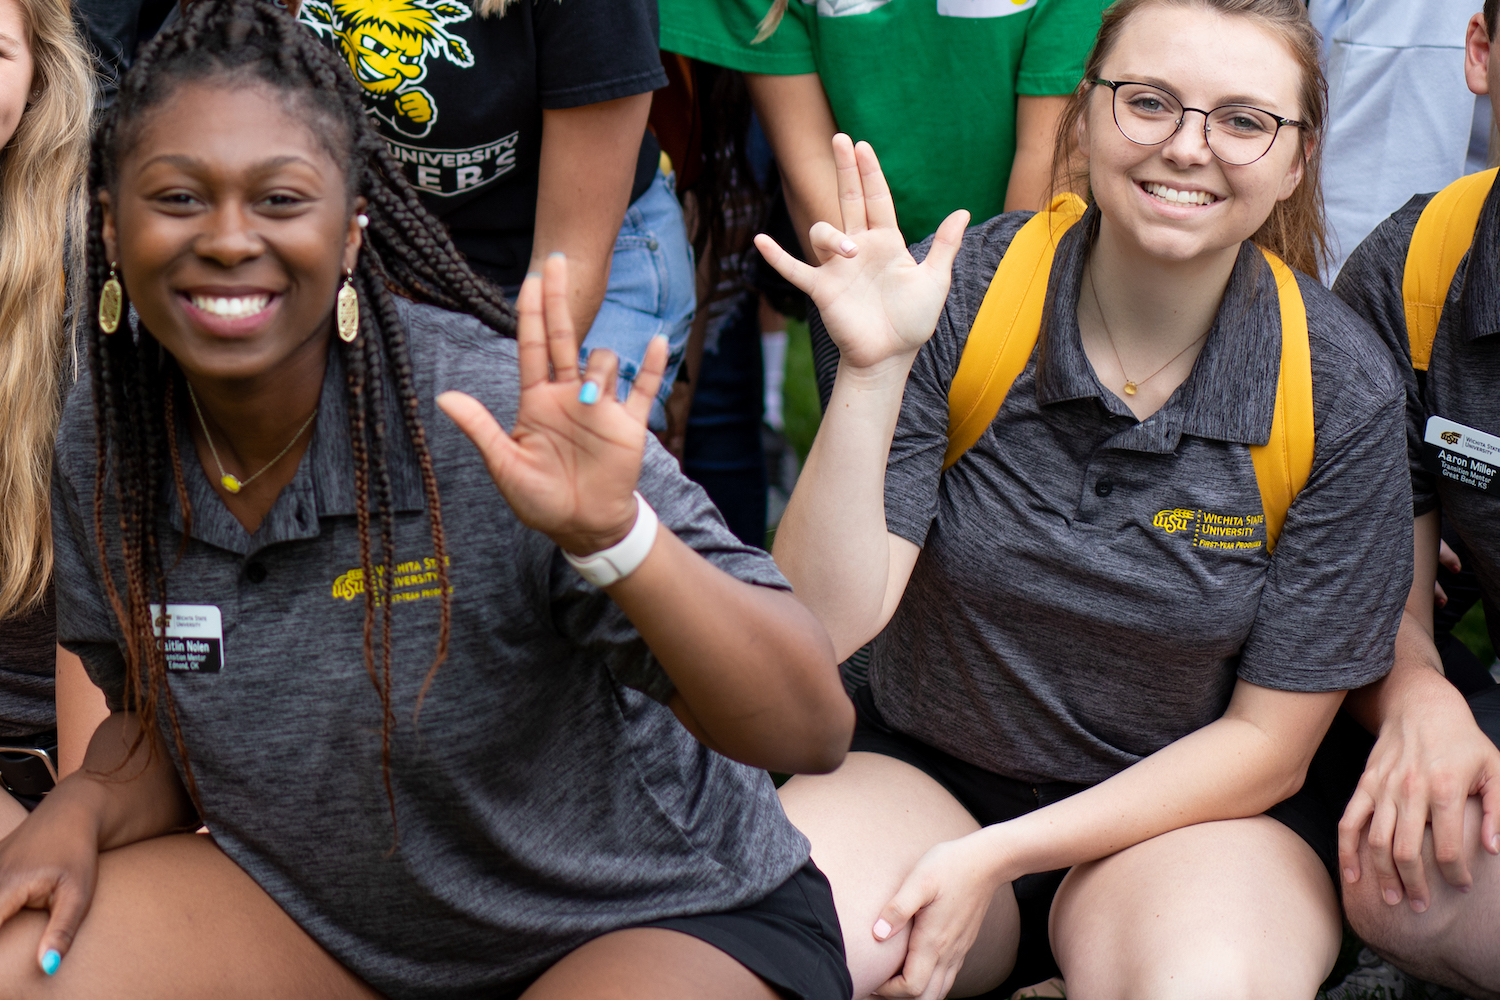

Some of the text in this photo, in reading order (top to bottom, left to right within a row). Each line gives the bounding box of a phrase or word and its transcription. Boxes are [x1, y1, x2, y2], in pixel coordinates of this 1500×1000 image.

[387, 134, 519, 168] UNIVERSITY
[1465, 442, 1493, 455] UNIVERSITY
[1466, 436, 1486, 448] WICHITA
[1438, 449, 1497, 477] Aaron Miller
[1441, 460, 1491, 483] Transition Mentor
[1442, 469, 1488, 490] Great Bend, KS
[1203, 512, 1244, 526] WICHITA
[1246, 514, 1264, 525] STATE
[1202, 524, 1255, 537] UNIVERSITY
[1199, 539, 1234, 550] FIRST-YEAR
[186, 640, 210, 653] Nolen
[186, 653, 206, 662] Mentor
[190, 662, 199, 670] OK
